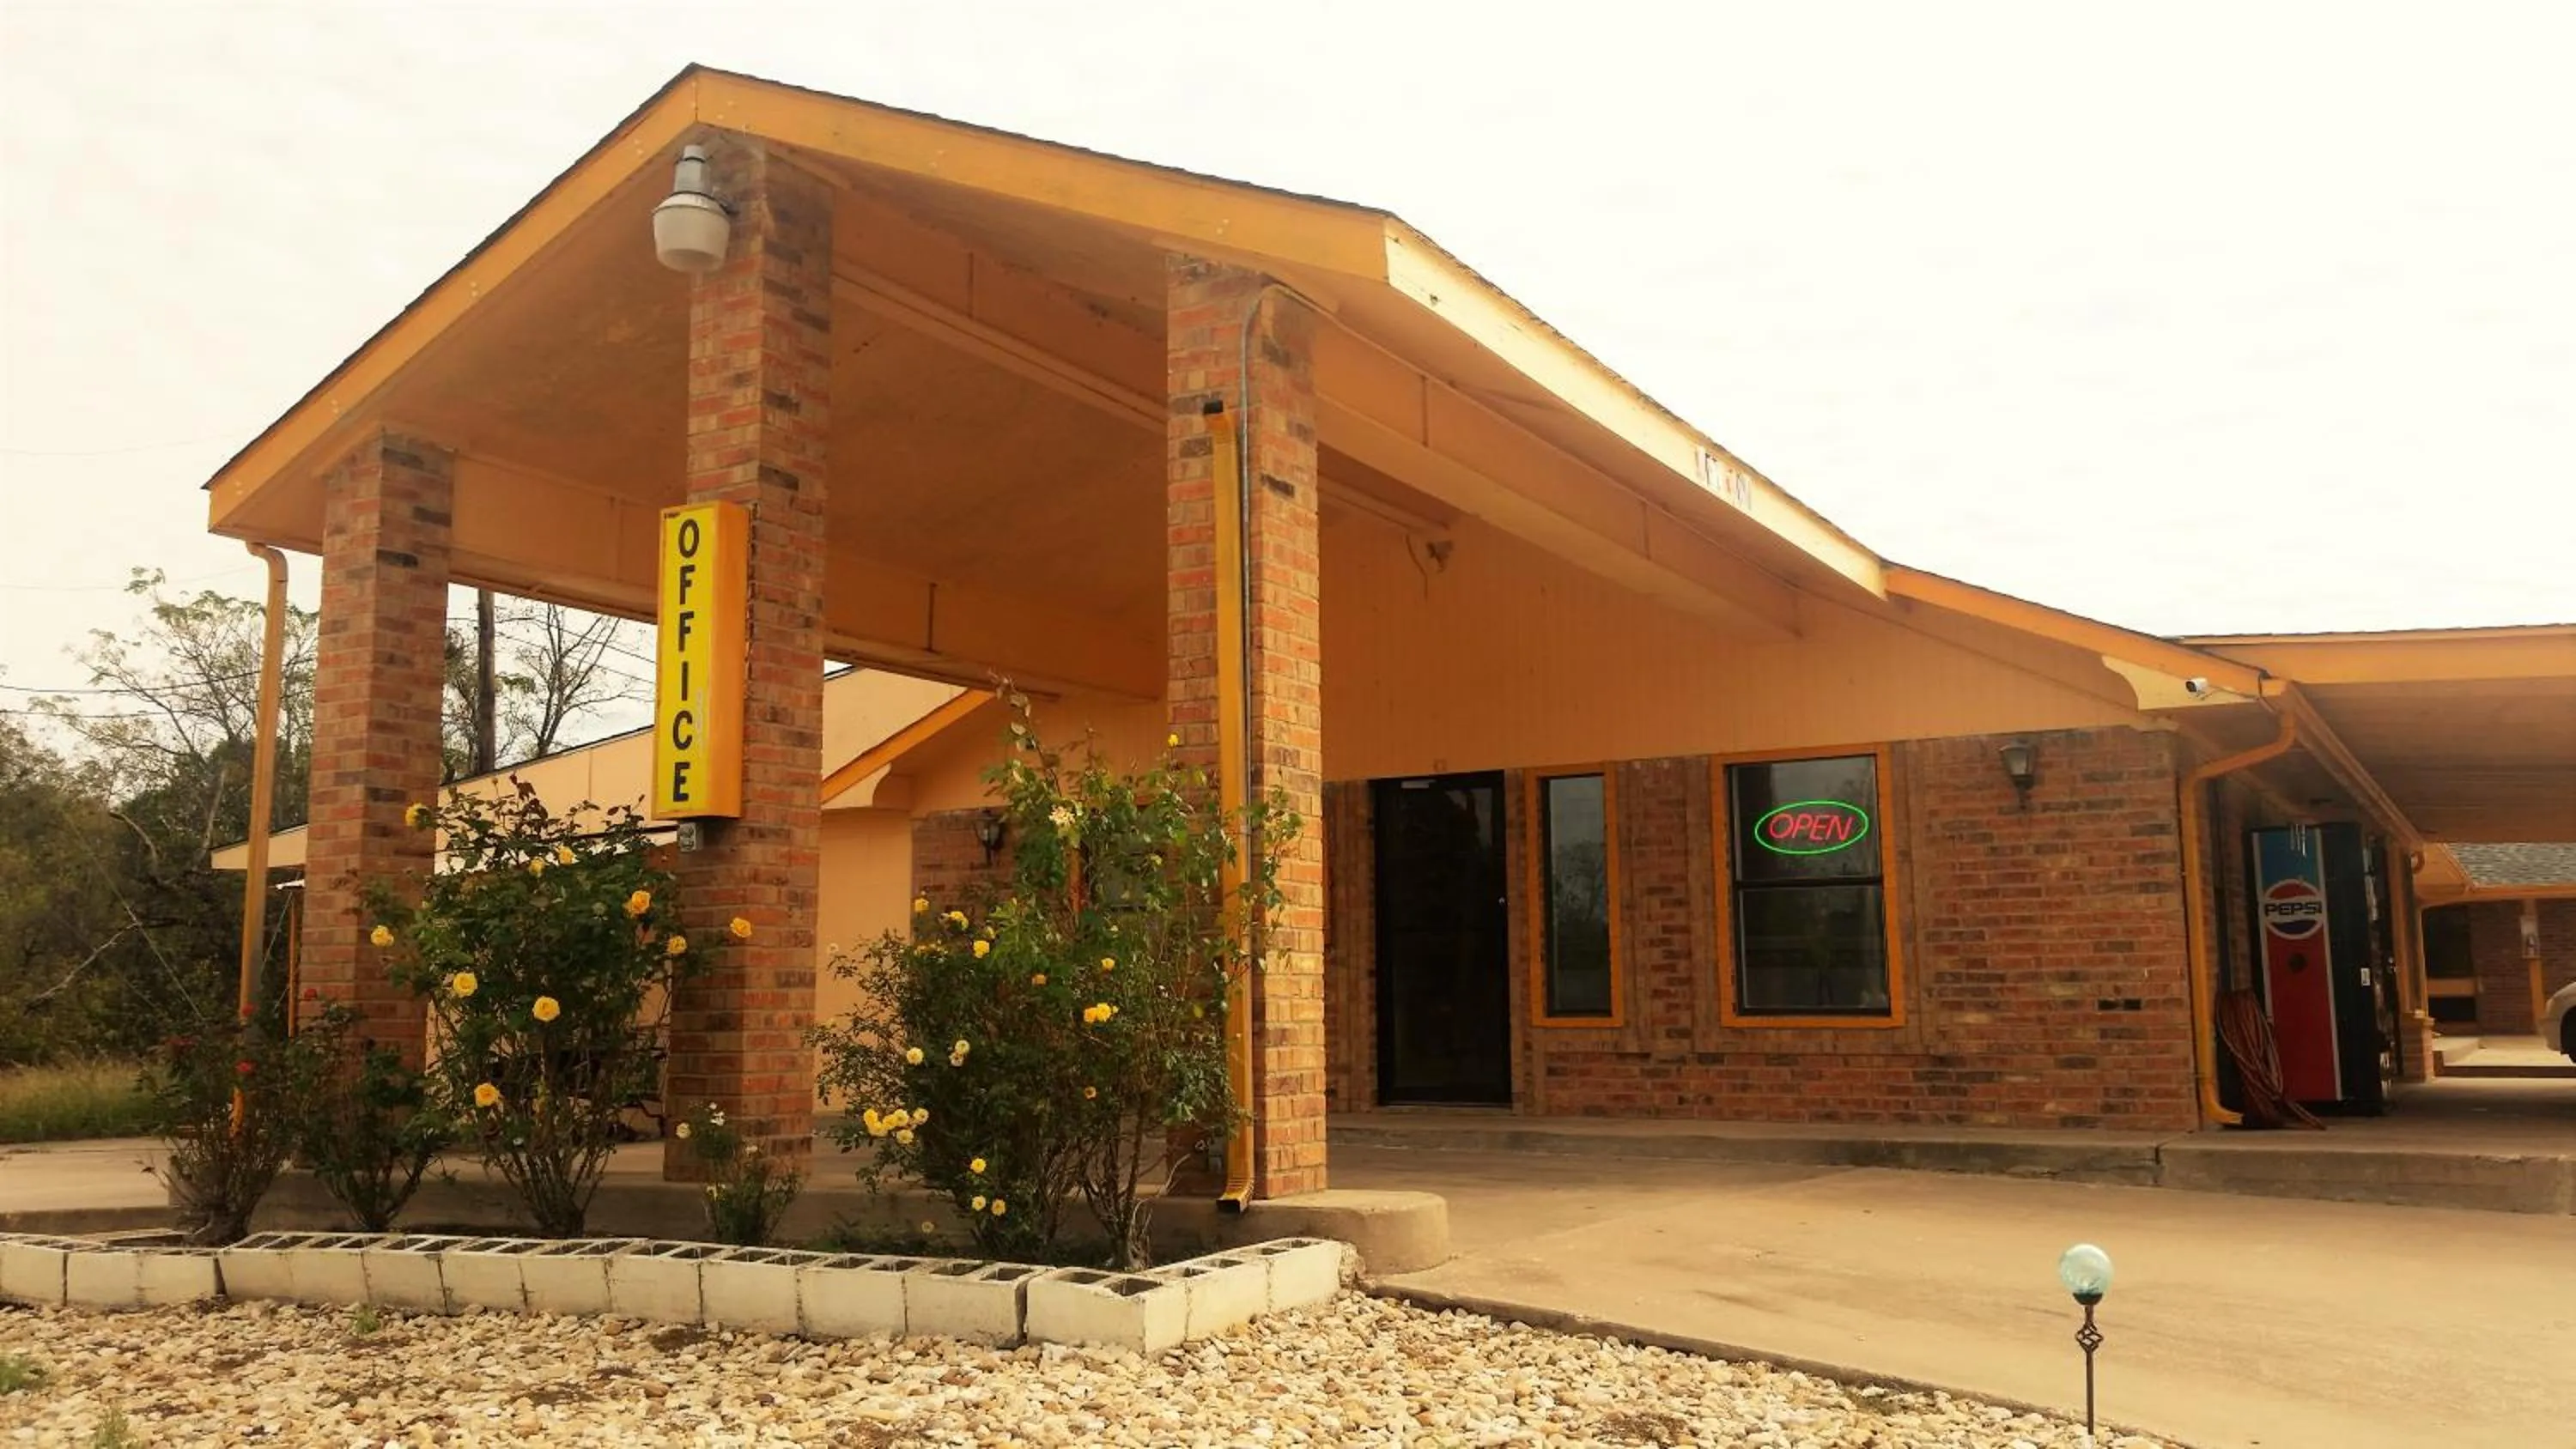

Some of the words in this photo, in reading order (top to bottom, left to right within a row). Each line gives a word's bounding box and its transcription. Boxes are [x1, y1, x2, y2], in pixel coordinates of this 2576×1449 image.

[672, 518, 700, 802] OFFICE
[1770, 813, 1855, 840] OPEN
[2264, 901, 2322, 917] PEPSI
